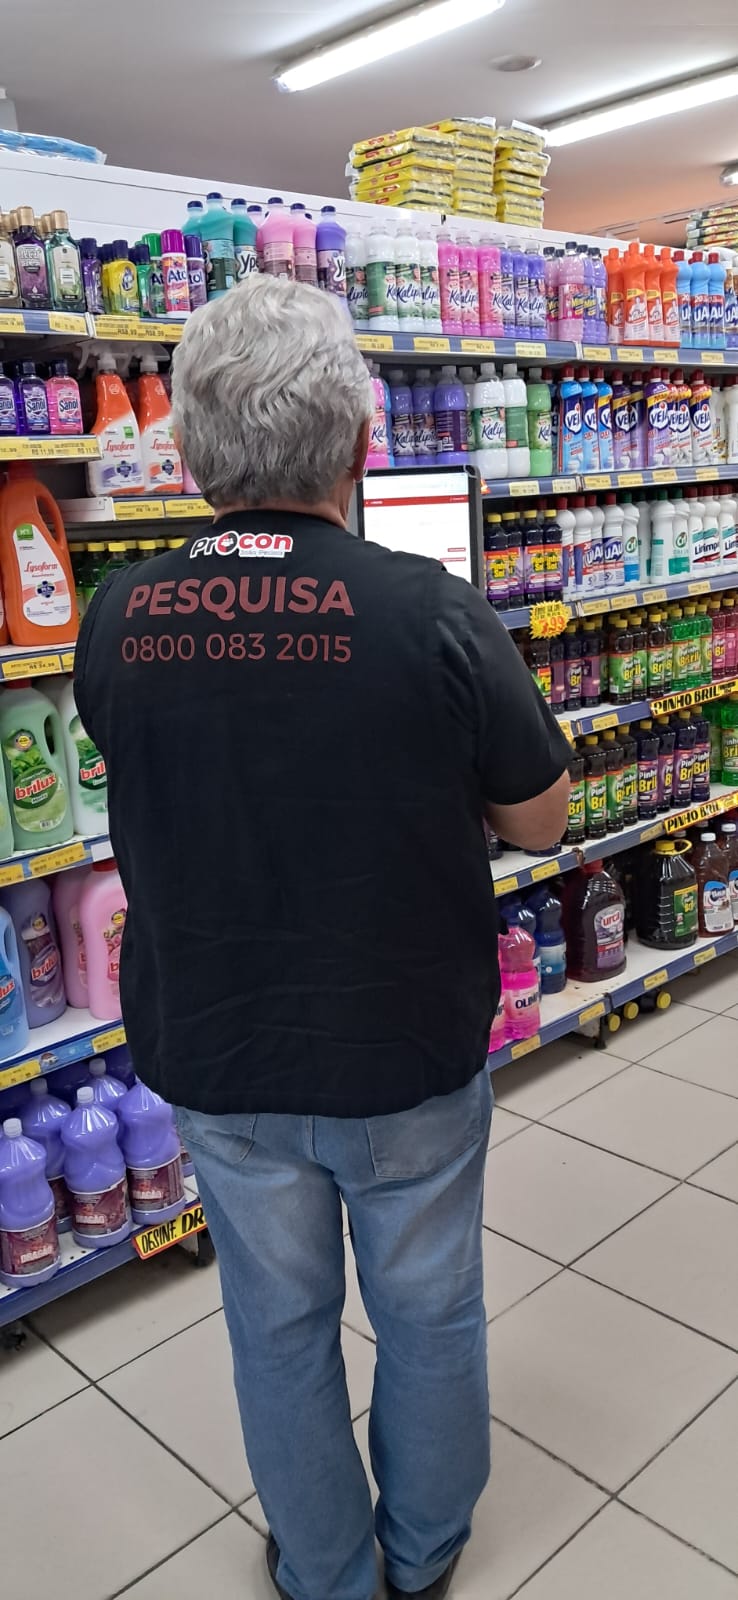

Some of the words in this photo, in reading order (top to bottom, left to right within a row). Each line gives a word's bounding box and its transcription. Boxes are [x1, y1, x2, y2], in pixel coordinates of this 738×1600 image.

[26, 399, 45, 413] Sanol
[58, 399, 79, 412] Sanol
[24, 561, 58, 574] Lysoform
[125, 576, 355, 621] PESQUISA
[121, 634, 195, 663] 0800
[206, 632, 266, 661] 083
[276, 633, 352, 663] 2015
[654, 692, 692, 715] PINHO
[694, 685, 719, 702] BRIL
[15, 773, 56, 801] brilux
